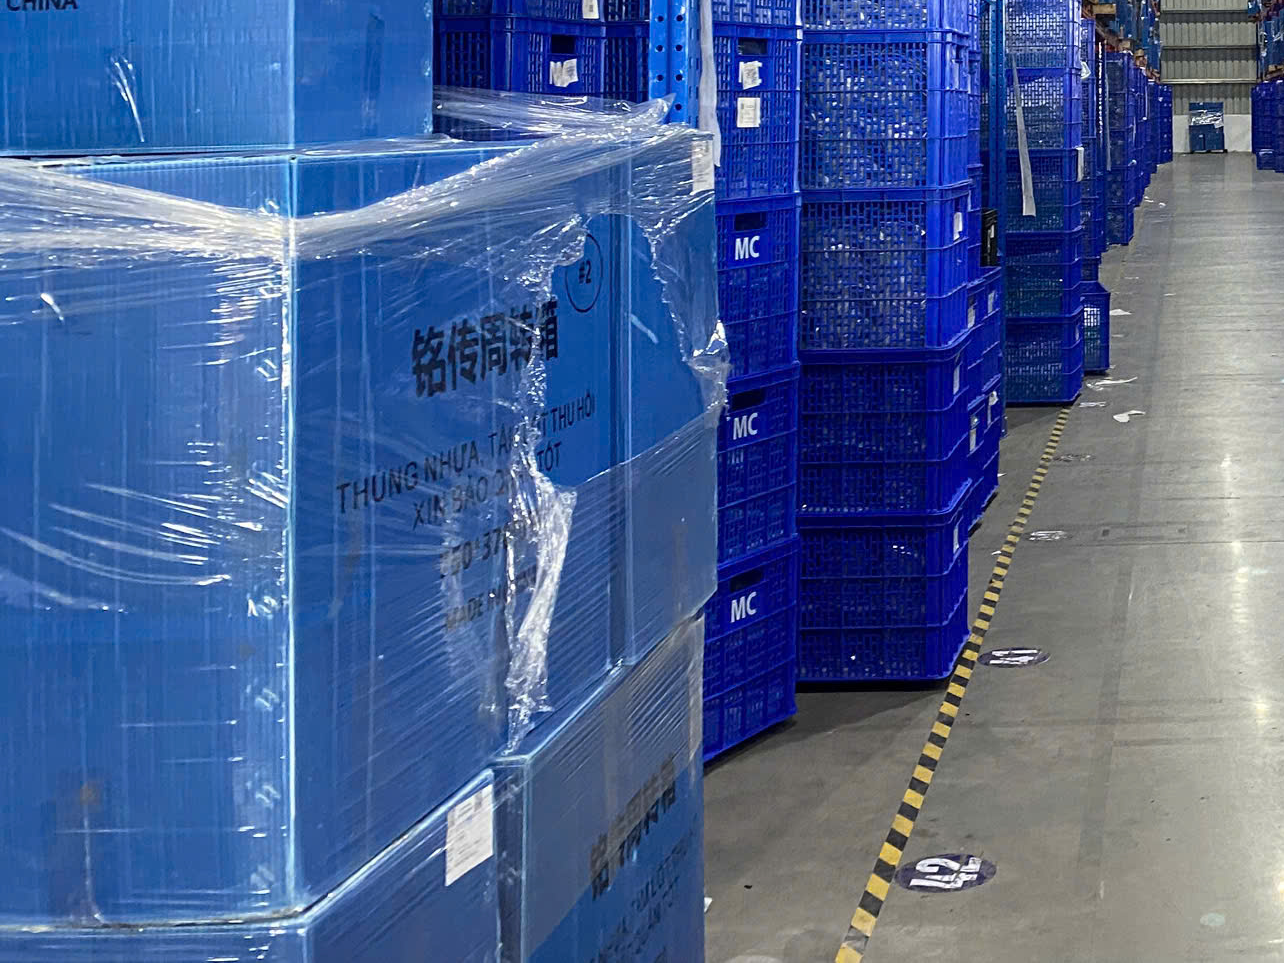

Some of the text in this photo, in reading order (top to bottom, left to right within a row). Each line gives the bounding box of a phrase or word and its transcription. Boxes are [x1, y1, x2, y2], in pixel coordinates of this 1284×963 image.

[734, 235, 760, 261] MC
[578, 259, 592, 284] #2
[550, 405, 575, 433] THU
[732, 412, 759, 440] MC
[730, 592, 757, 624] MC
